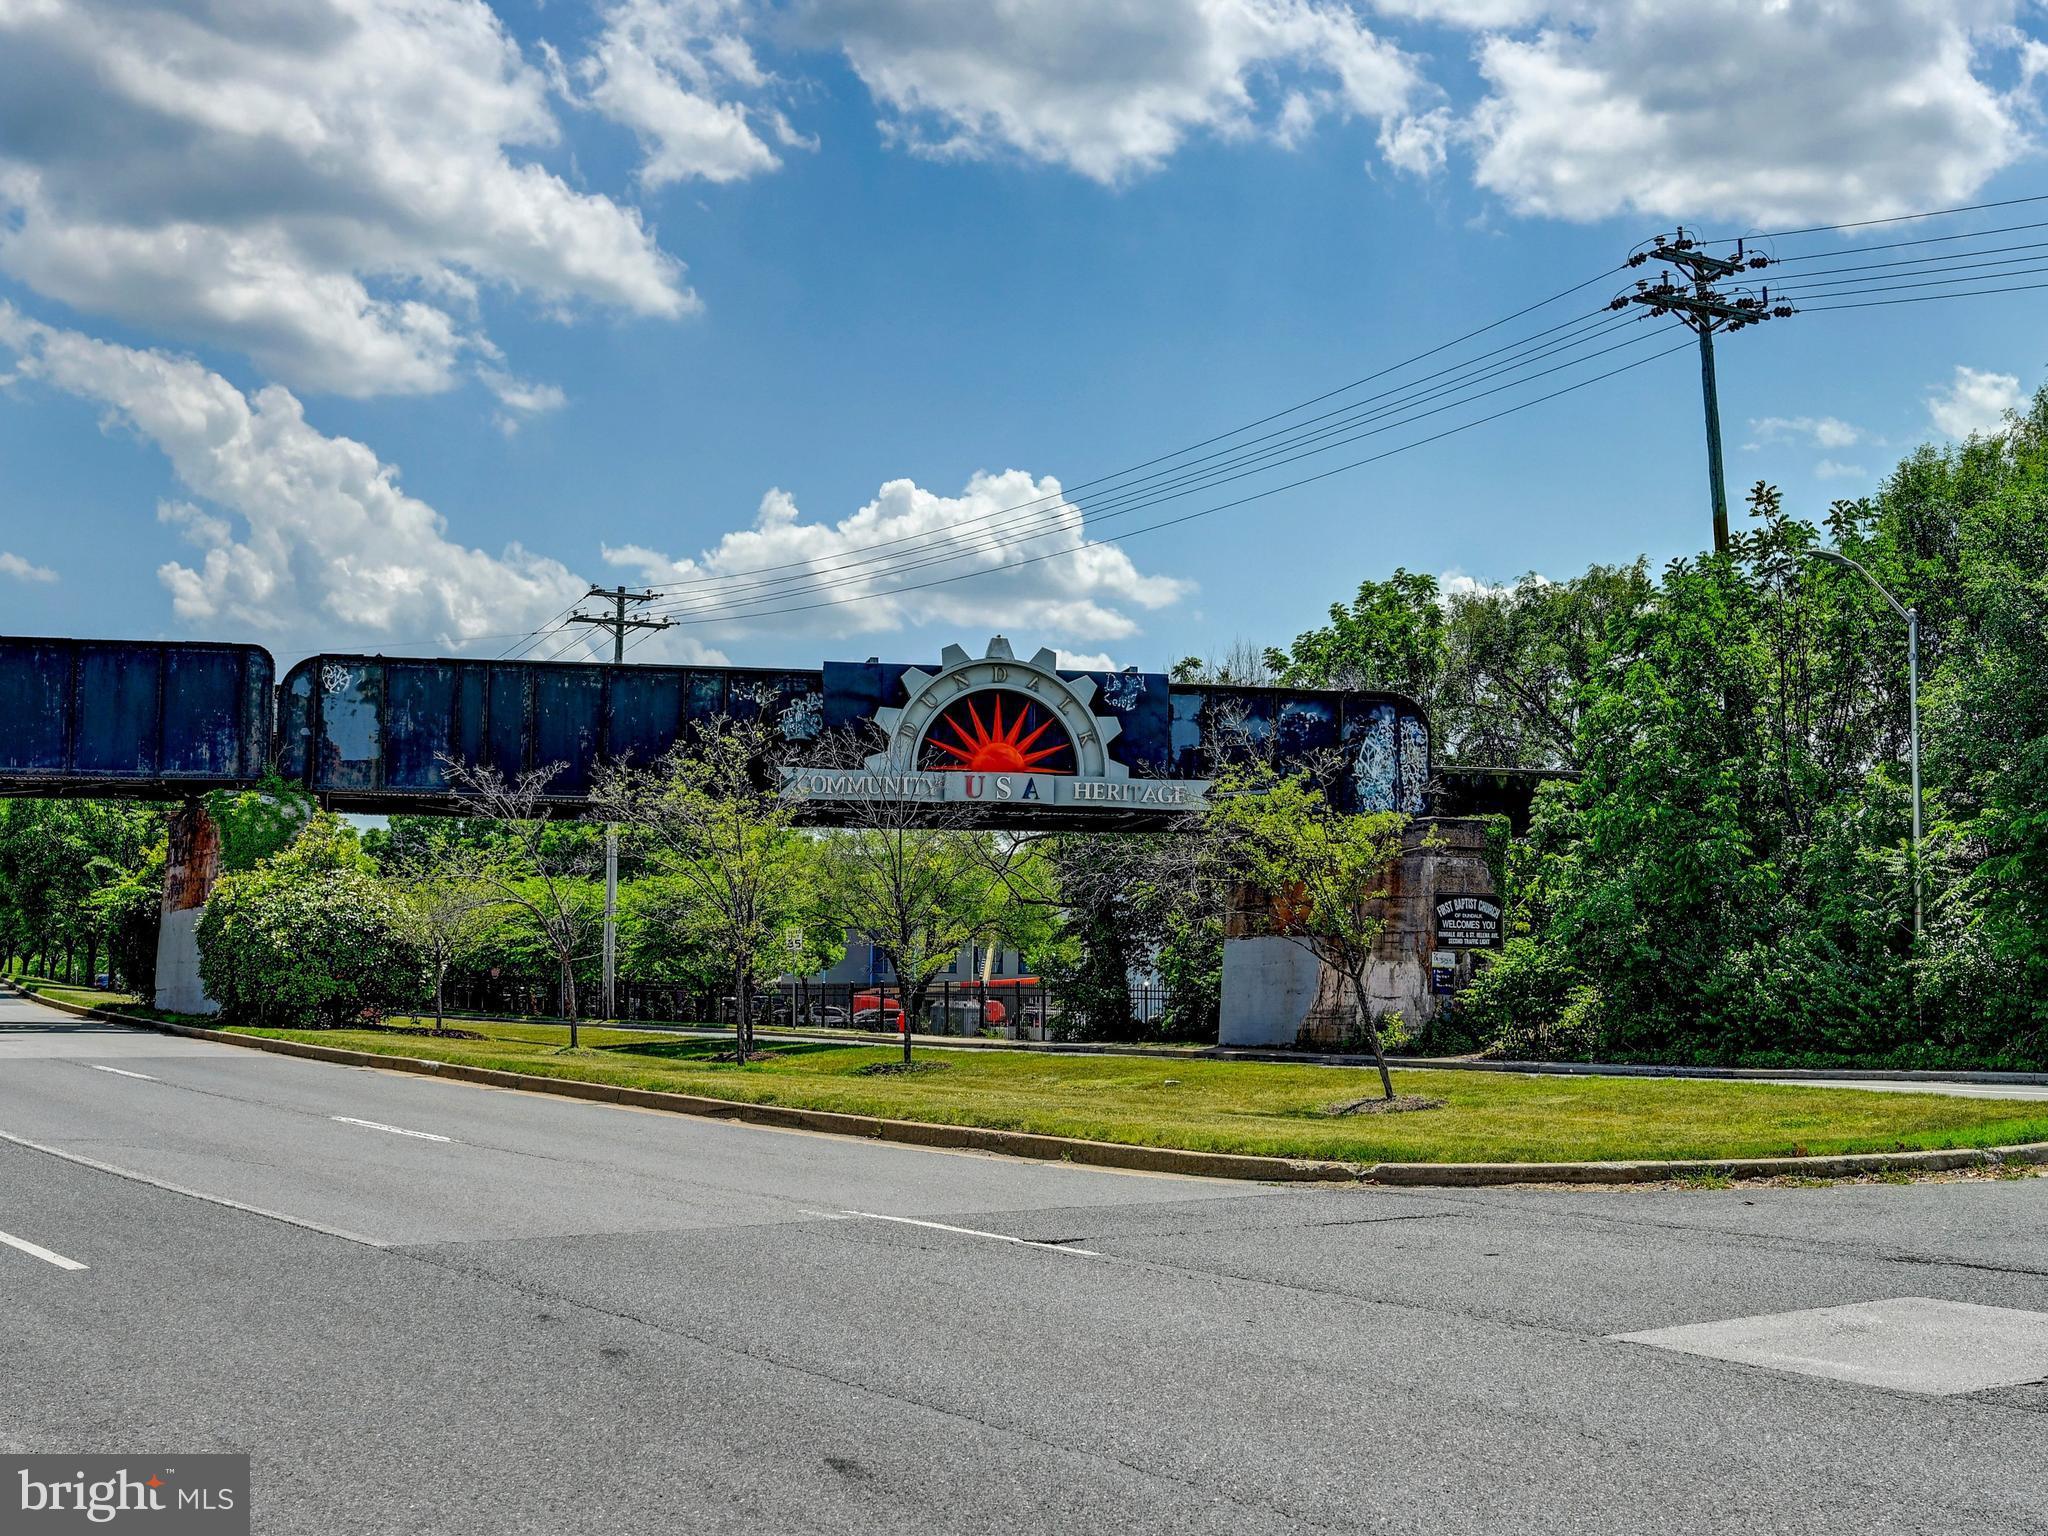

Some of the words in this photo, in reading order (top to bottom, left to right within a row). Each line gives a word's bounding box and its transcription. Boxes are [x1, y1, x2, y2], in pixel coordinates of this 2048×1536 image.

[901, 665, 1096, 747] DUNDALK
[797, 775, 937, 796] COMMUNITY
[1073, 781, 1186, 804] HERITAGE
[1436, 900, 1453, 917] FIRST
[1454, 898, 1477, 910] BAPTIST
[1478, 900, 1500, 919] CHURCH
[1442, 920, 1480, 929] WELCOMES
[1482, 920, 1496, 930] YOU
